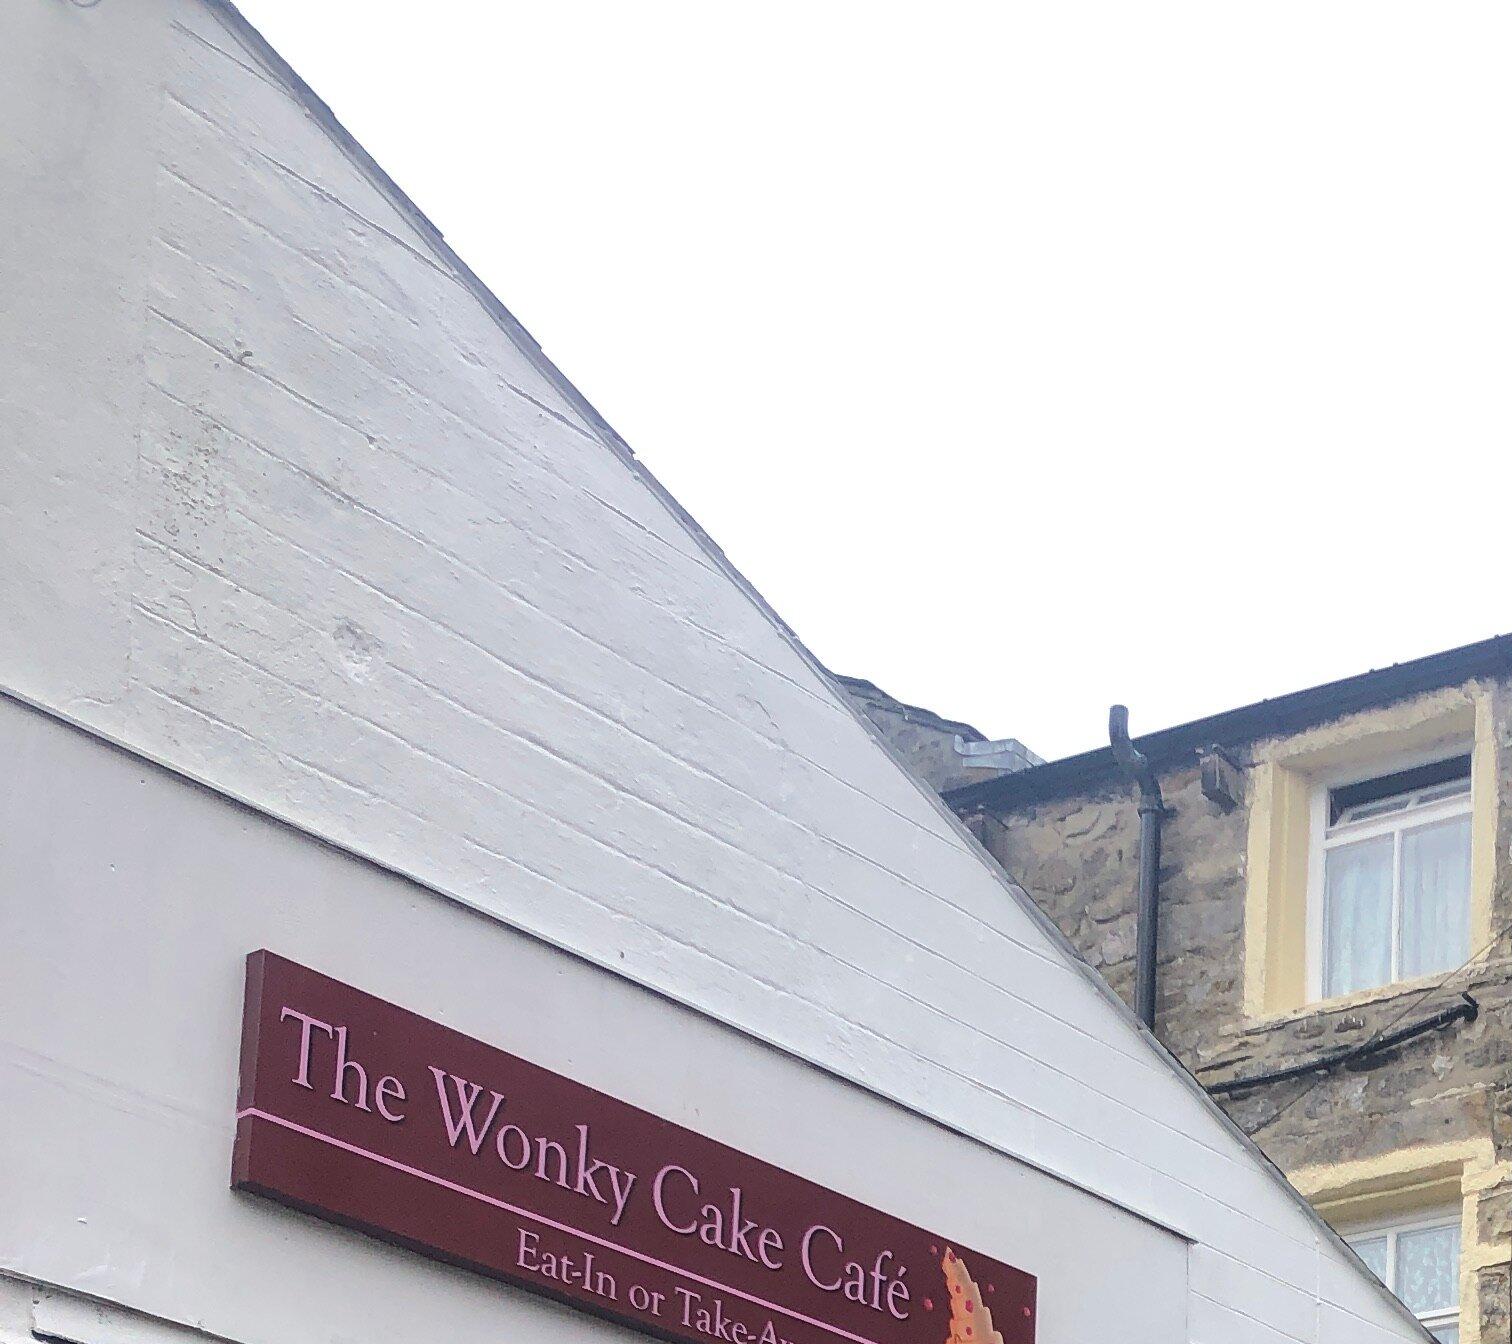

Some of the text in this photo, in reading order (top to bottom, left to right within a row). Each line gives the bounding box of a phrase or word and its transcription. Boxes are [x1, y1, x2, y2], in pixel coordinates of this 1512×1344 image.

[279, 1006, 911, 1321] The Wonky Cake Café
[516, 1228, 619, 1301] Eat-In
[628, 1281, 666, 1316] or
